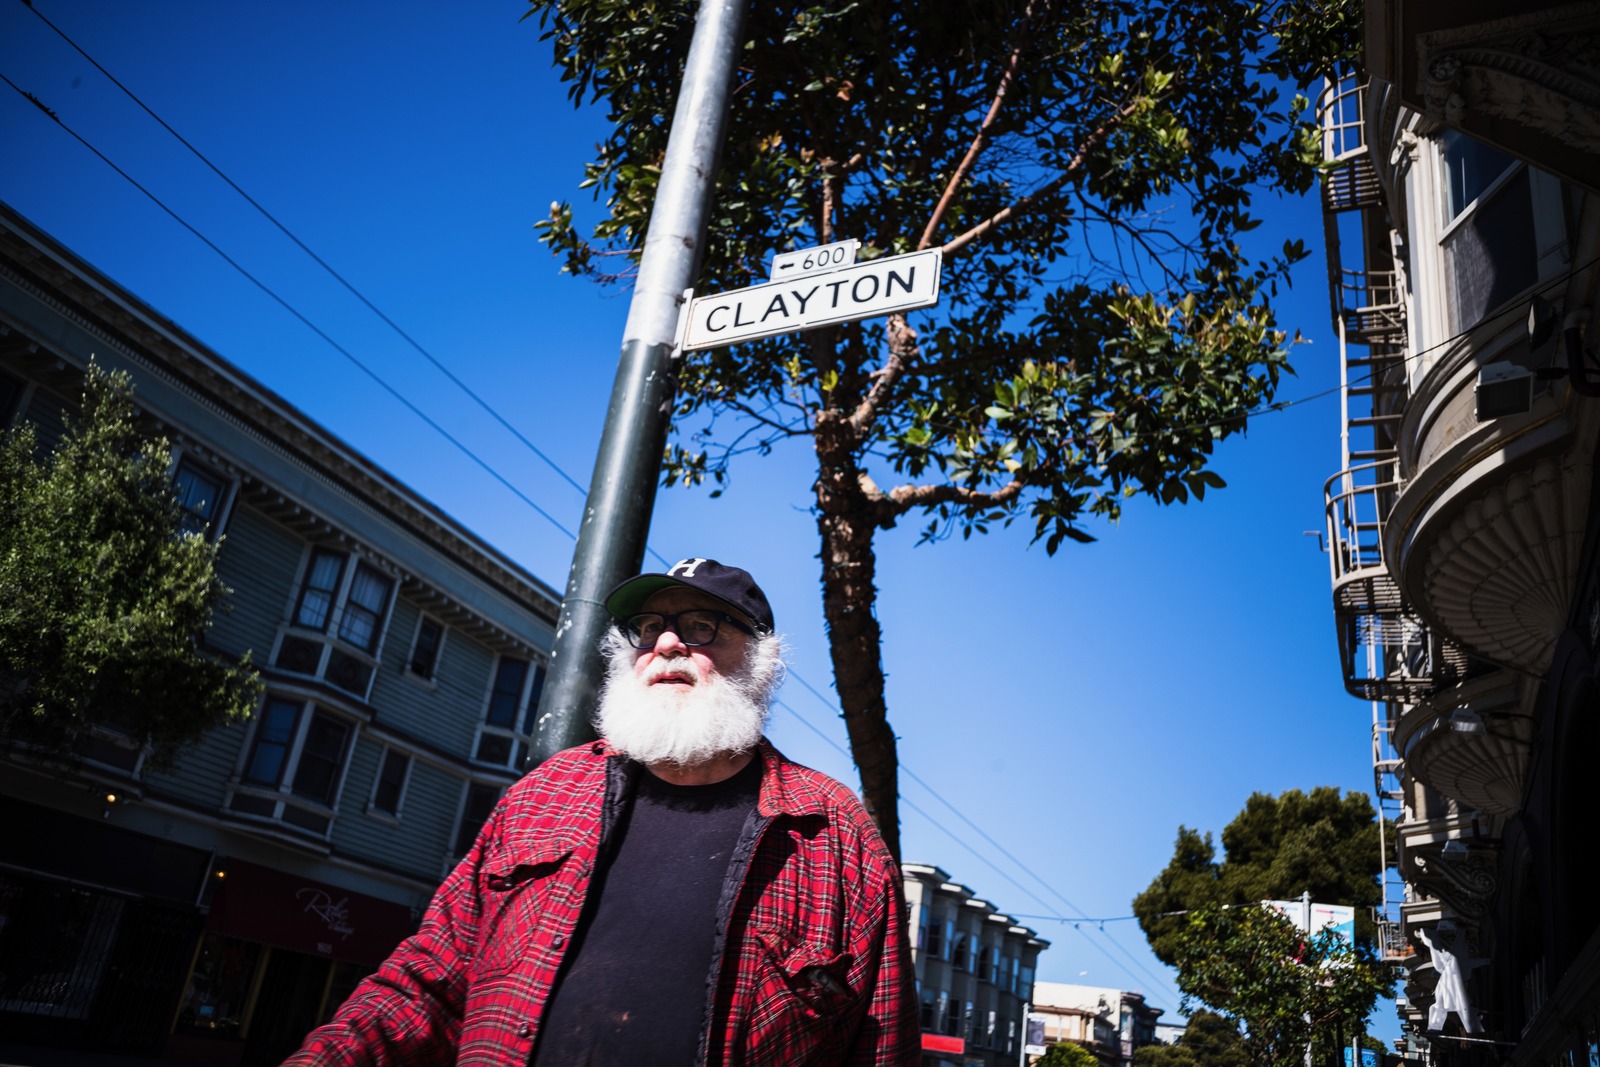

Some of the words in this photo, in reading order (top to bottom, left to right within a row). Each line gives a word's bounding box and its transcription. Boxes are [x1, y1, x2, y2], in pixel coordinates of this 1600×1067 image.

[802, 246, 846, 271] 600
[705, 266, 916, 332] CLAYTON
[666, 557, 707, 578] H
